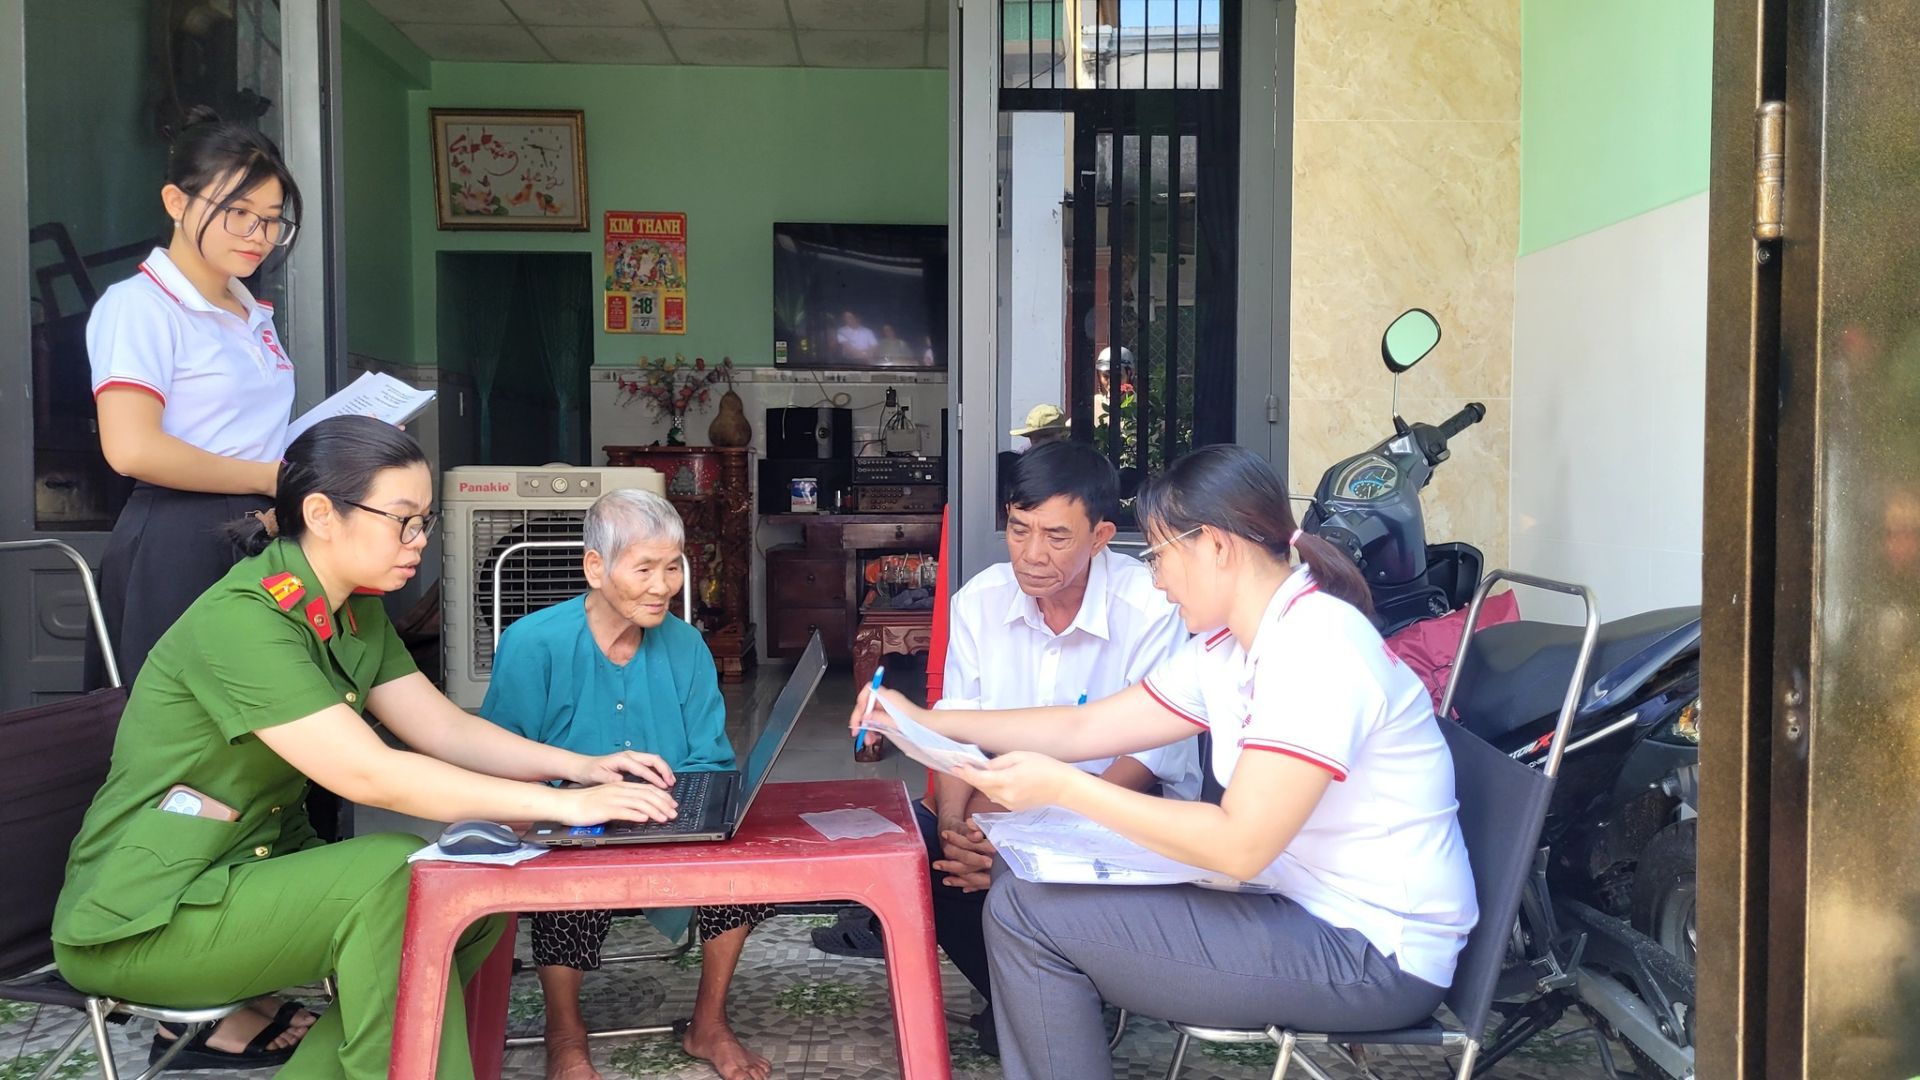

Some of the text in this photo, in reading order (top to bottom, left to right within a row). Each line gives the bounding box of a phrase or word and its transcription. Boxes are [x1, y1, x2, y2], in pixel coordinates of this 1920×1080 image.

[609, 218, 681, 234] KIM THANH
[638, 297, 653, 314] 18
[460, 482, 510, 492] Panakio
